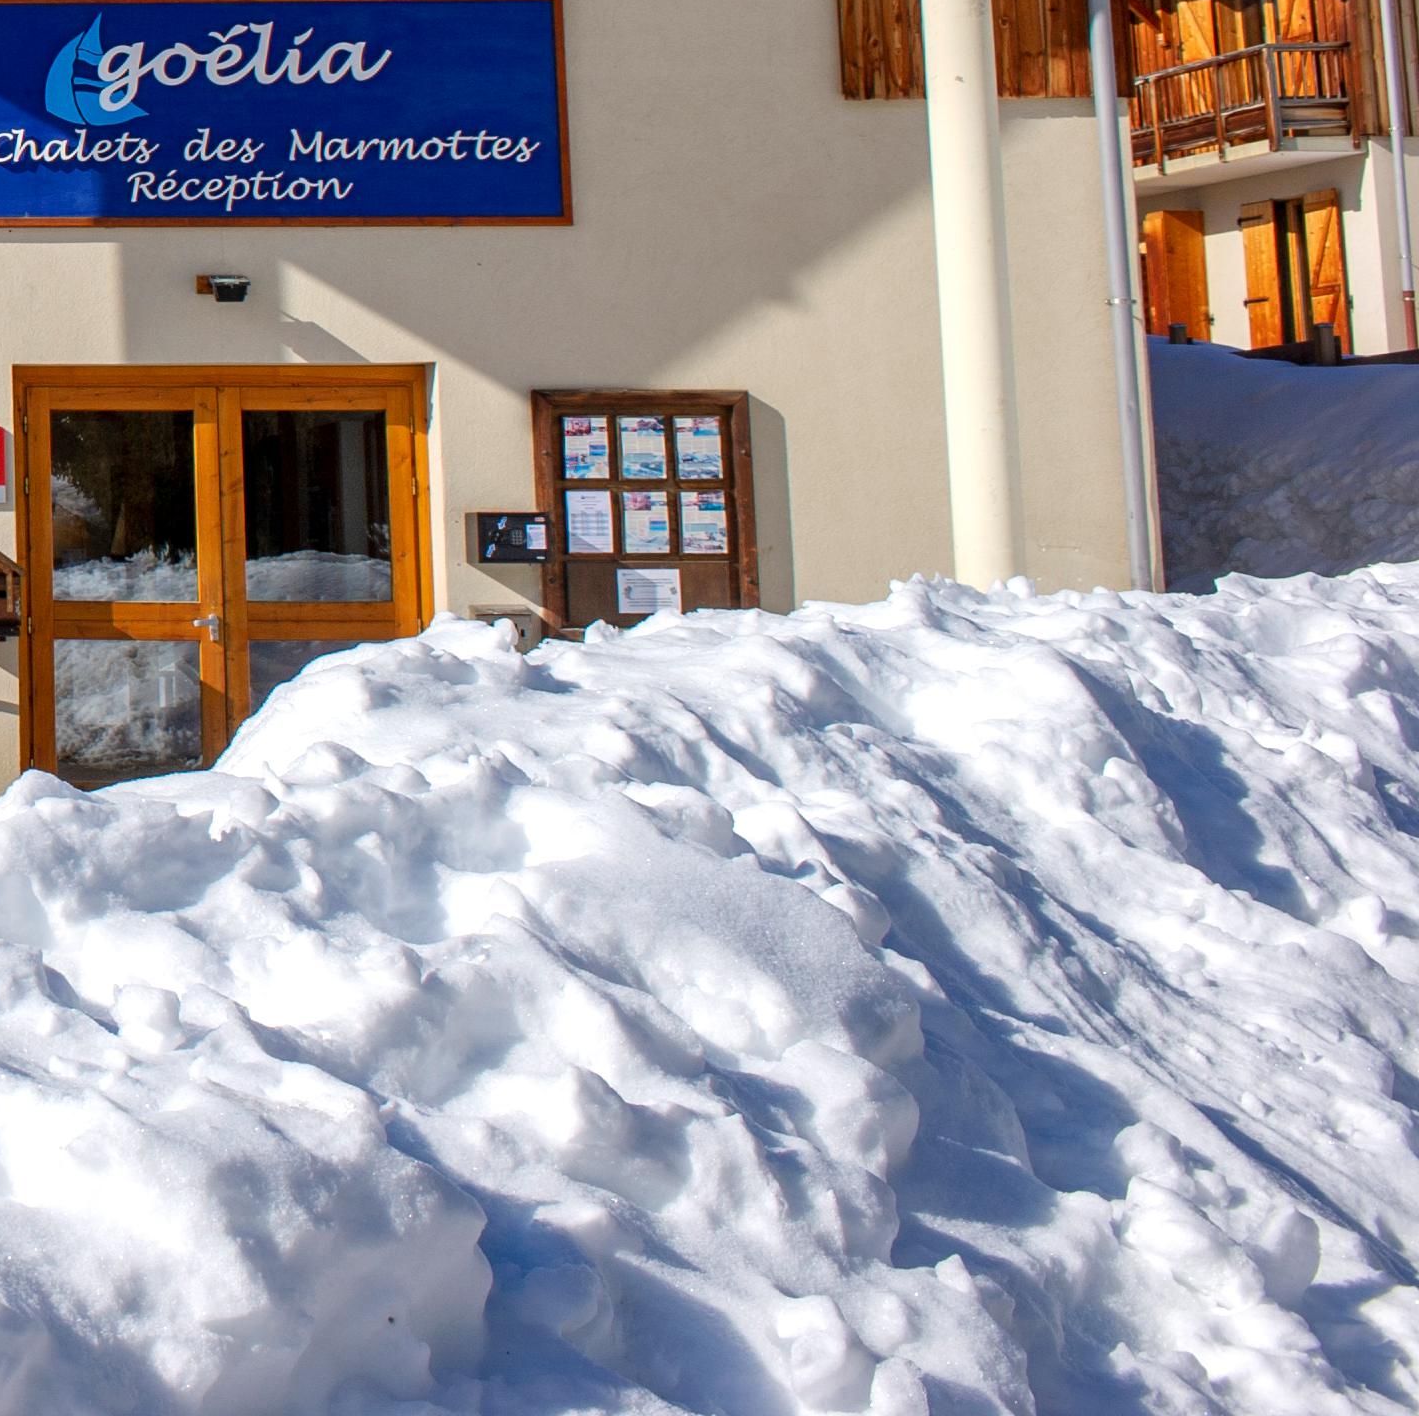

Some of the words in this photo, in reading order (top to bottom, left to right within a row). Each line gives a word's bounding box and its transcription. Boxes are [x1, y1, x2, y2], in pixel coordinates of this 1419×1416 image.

[97, 21, 393, 112] goélia
[183, 128, 264, 164] des
[288, 128, 540, 163] Marmottes
[126, 169, 354, 212] Réception
